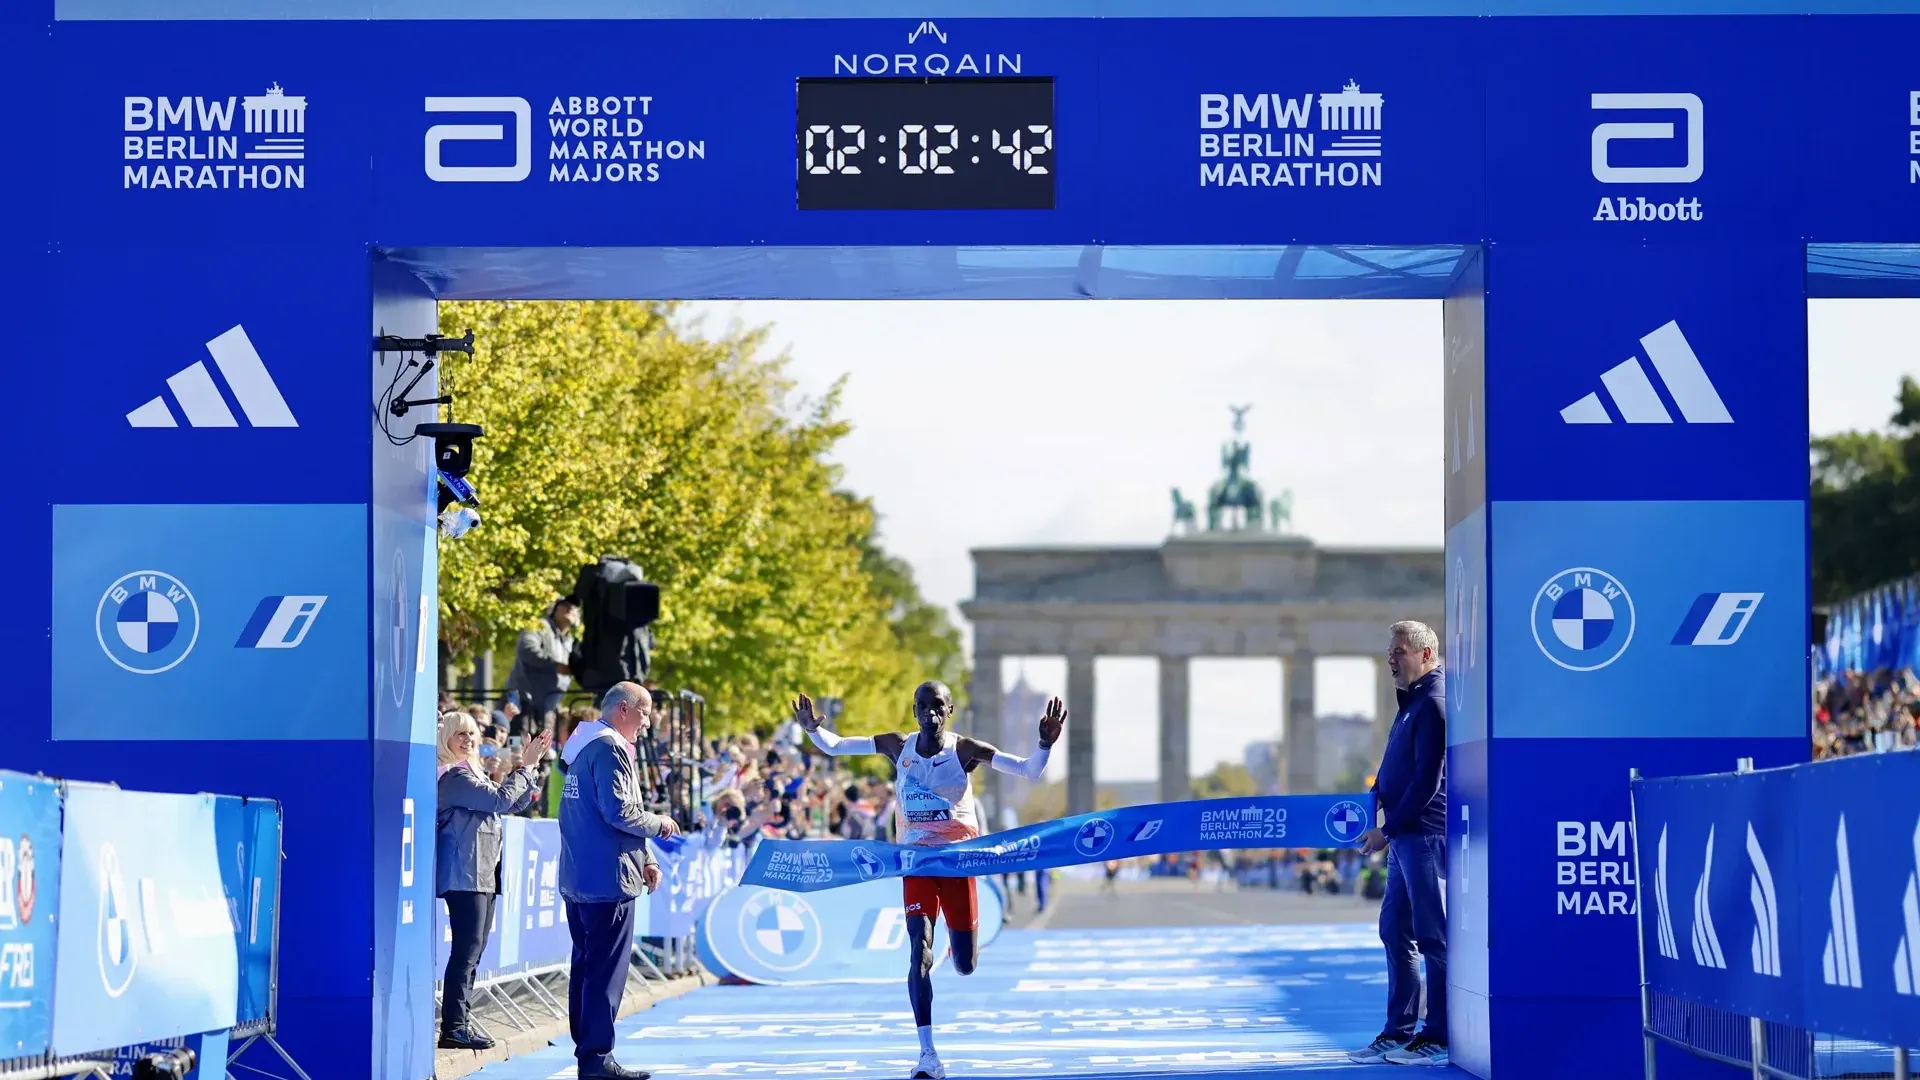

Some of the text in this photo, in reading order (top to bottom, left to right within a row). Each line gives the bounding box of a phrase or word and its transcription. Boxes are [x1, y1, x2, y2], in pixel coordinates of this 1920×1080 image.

[834, 53, 1021, 76] NORQAIN
[124, 96, 237, 132] BMW
[548, 96, 653, 115] ABBOTT
[1200, 93, 1312, 129] BMW
[548, 117, 644, 137] WORLD
[124, 135, 238, 160] BERLIN
[549, 140, 705, 160] MARATHON
[805, 124, 1053, 175] 02:02:42
[1200, 133, 1314, 158] BERLIN
[124, 164, 305, 189] MARATHON
[548, 162, 660, 183] MAJORS
[1200, 162, 1382, 187] MARATHON
[1592, 196, 1703, 222] Abbott
[110, 576, 186, 604] BMW
[1545, 573, 1622, 601] BMW
[570, 774, 579, 787] 20
[570, 787, 580, 798] 23
[906, 793, 940, 801] KIPCHO
[1201, 809, 1240, 822] BMW
[1264, 808, 1287, 823] 20
[1200, 830, 1262, 841] MARATHON
[1201, 822, 1239, 831] BERLIN
[1263, 824, 1287, 839] 23
[1018, 835, 1040, 852] 20
[1557, 821, 1633, 857] BM
[770, 851, 801, 866] BMW
[816, 852, 830, 867] 20
[956, 855, 1015, 868] MARATHON
[1016, 849, 1038, 862] 23
[763, 871, 816, 883] MARATHON
[767, 863, 801, 874] BERLIN
[816, 868, 833, 883] 23
[1557, 891, 1637, 915] MAR
